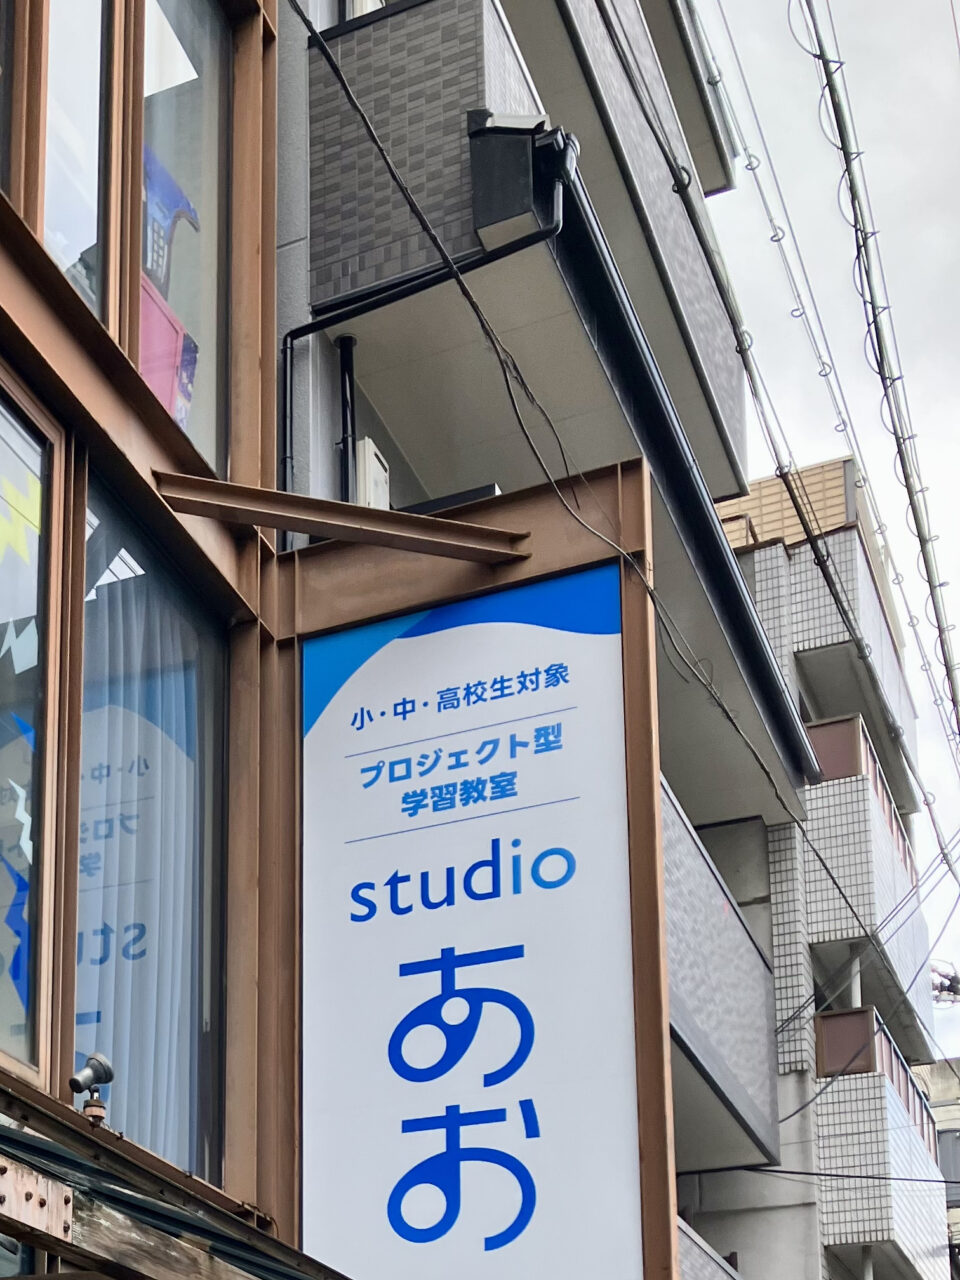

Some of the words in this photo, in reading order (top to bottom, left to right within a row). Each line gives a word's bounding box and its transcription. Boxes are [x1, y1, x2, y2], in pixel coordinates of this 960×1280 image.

[360, 722, 564, 790] プロジェクト型
[400, 770, 519, 818] 学習教室
[349, 837, 577, 923] studio
[387, 944, 541, 1252] あお
